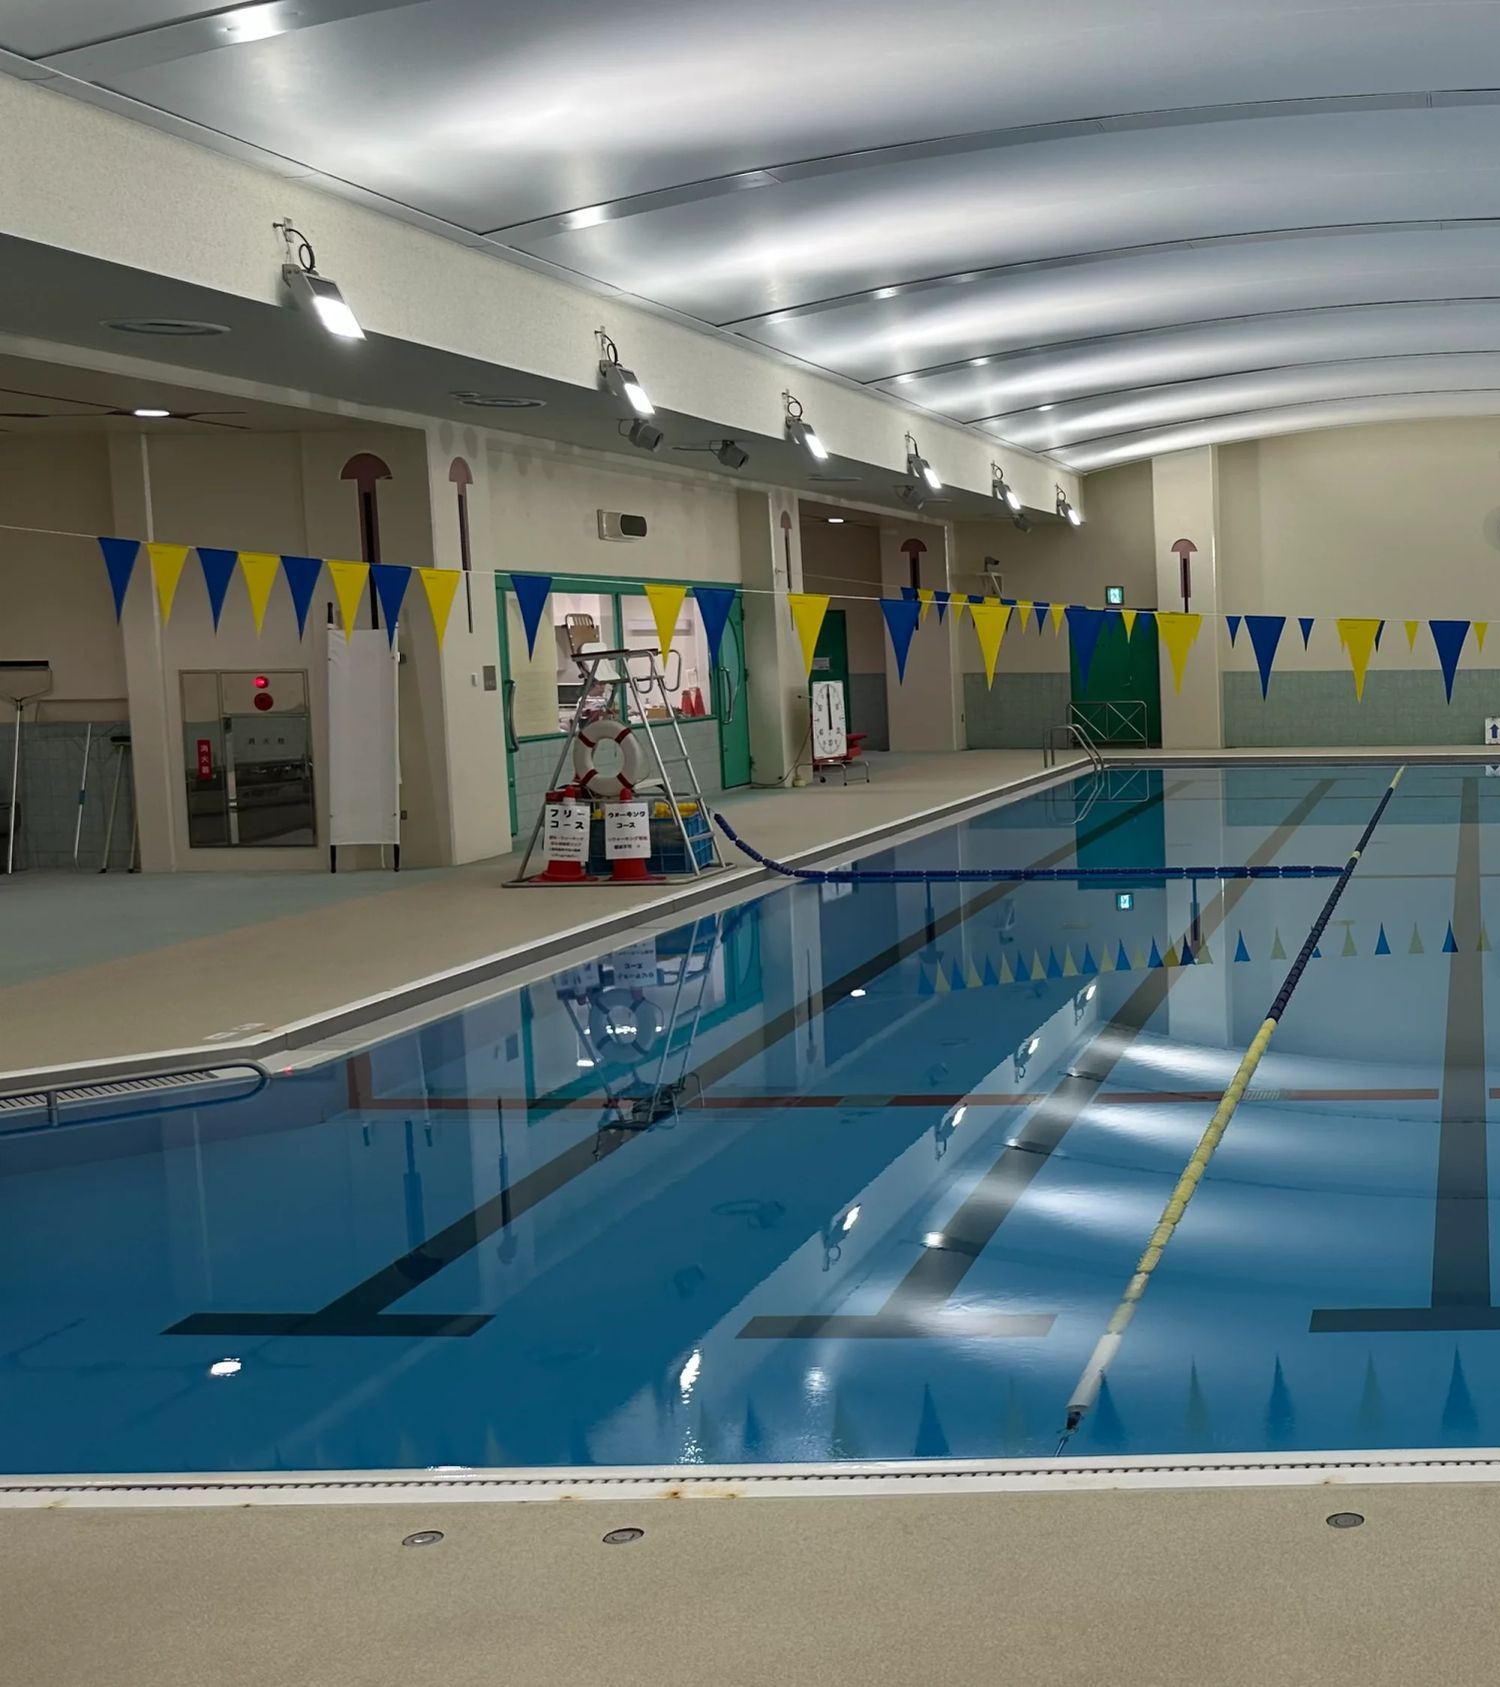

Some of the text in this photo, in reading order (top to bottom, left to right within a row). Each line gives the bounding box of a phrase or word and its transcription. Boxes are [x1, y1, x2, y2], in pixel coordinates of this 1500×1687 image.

[550, 809, 585, 818] フリー
[550, 820, 584, 829] コース
